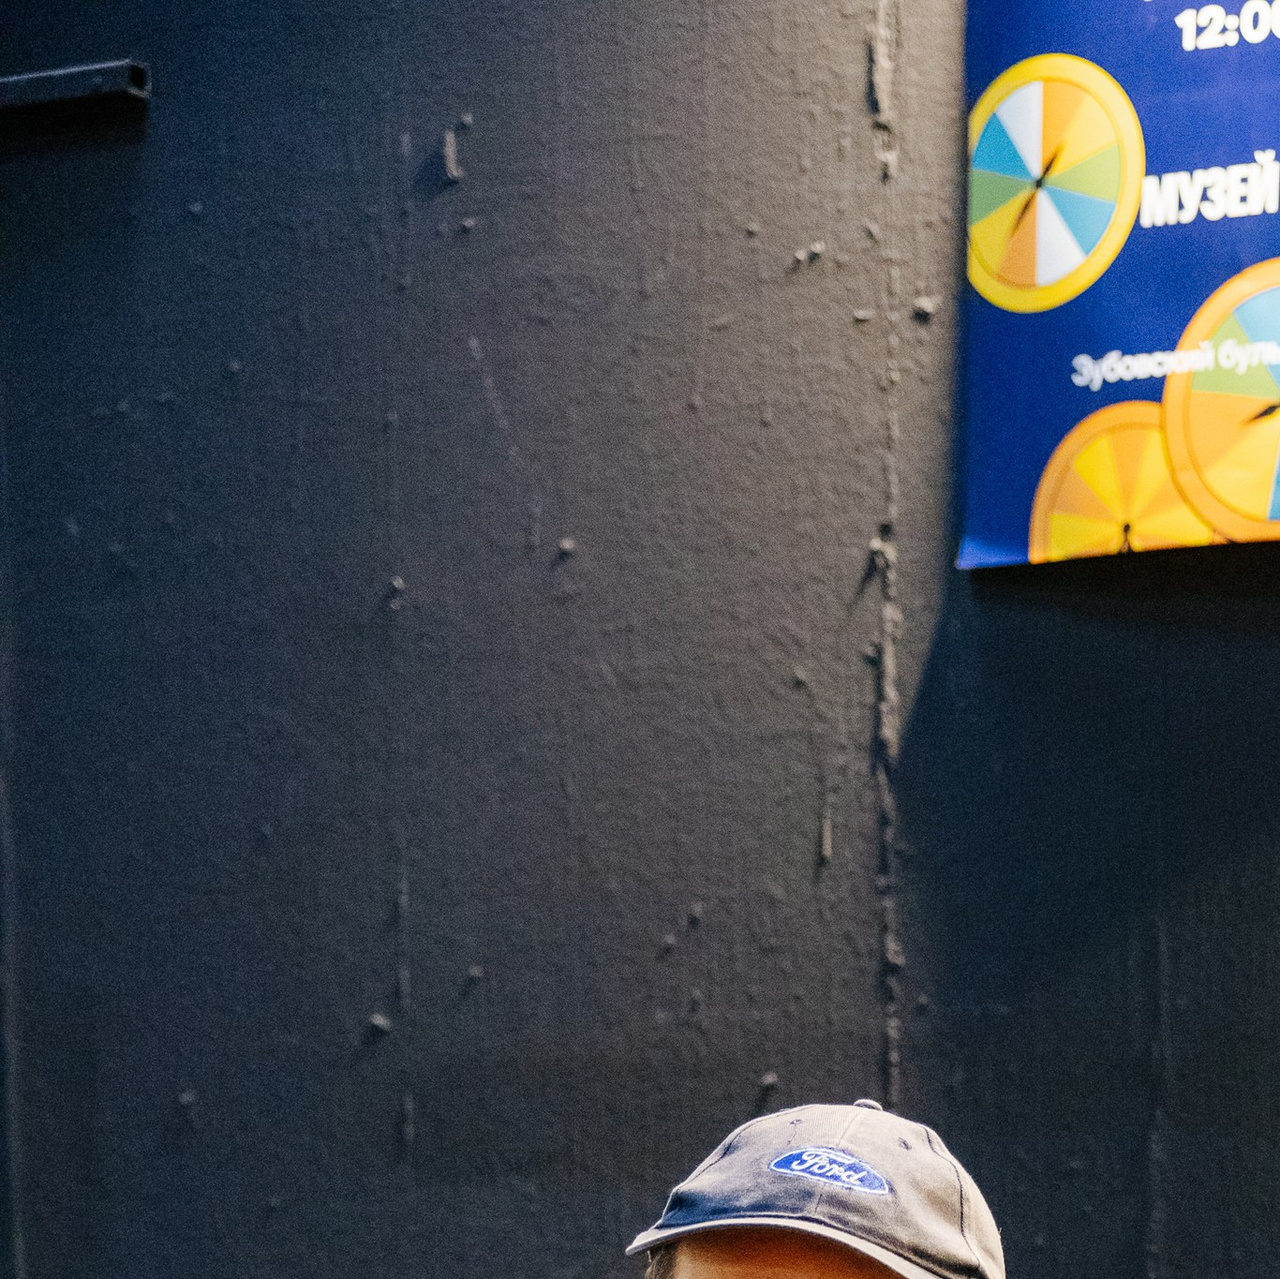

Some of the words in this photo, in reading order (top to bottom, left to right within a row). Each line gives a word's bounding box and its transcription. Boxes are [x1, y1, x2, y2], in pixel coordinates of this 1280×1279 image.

[1139, 149, 1280, 228] МУЗЕЙ
[1070, 341, 1215, 391] Зубовский
[789, 1149, 868, 1187] Ford
